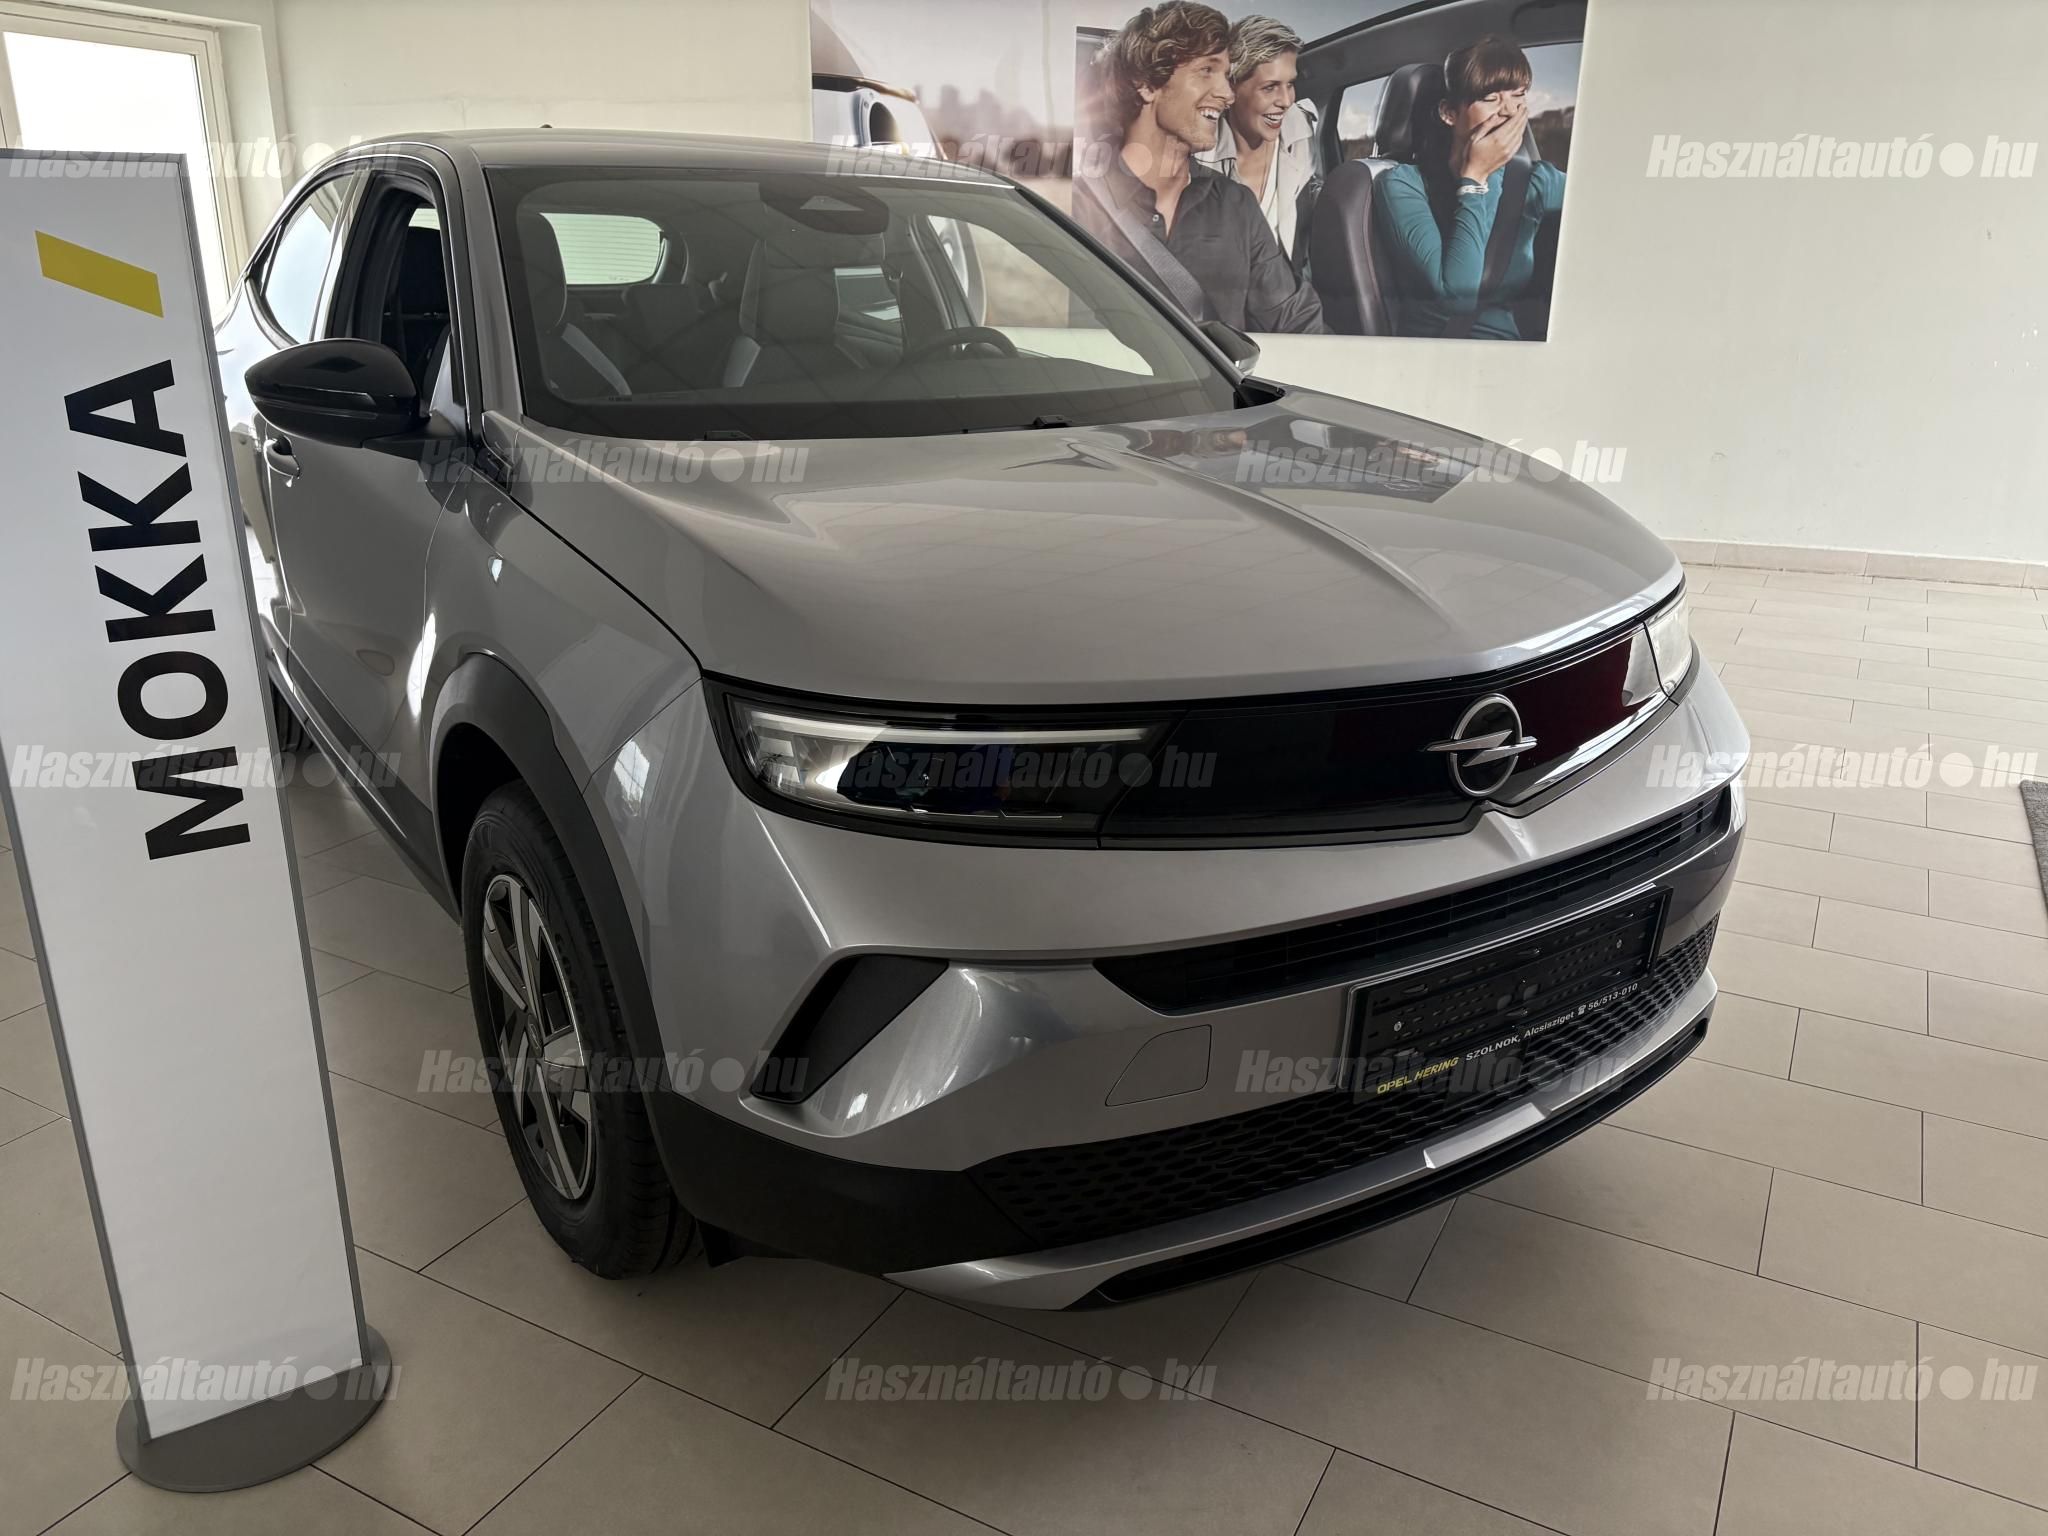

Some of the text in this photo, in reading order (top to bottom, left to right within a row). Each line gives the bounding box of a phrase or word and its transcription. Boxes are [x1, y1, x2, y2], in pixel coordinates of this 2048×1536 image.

[64, 359, 251, 861] MOKKA
[1377, 1075, 1412, 1094] OPEL
[1414, 1057, 1459, 1081] HERING
[1466, 1034, 1521, 1061] SZOLNOK,
[1588, 982, 1639, 1011] 56/513-010
